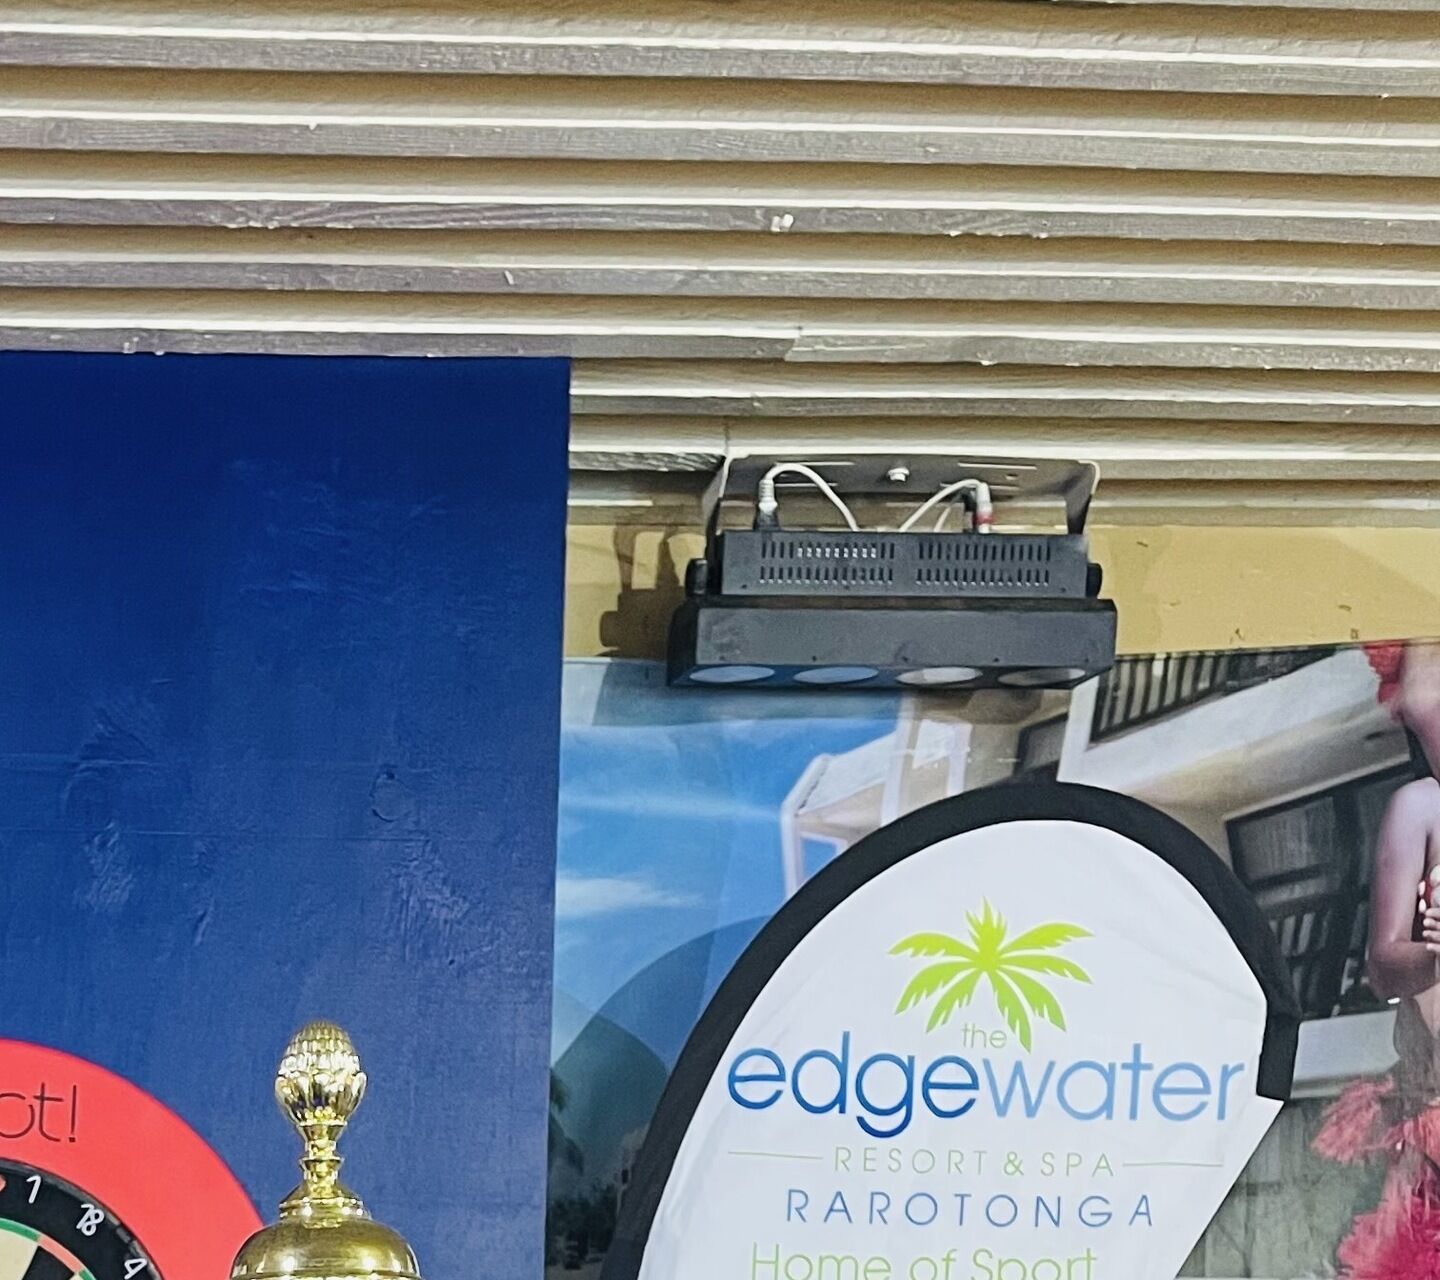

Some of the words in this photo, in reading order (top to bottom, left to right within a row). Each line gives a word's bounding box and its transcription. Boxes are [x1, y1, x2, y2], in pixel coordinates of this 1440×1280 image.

[962, 1023, 1007, 1049] the
[728, 1031, 1245, 1138] edgewater
[834, 1146, 988, 1175] RESORT
[1003, 1151, 1025, 1177] &
[1040, 1152, 1114, 1177] SPA
[26, 1175, 42, 1204] 1
[76, 1203, 105, 1236] 18
[786, 1189, 1153, 1228] RAROTONGA
